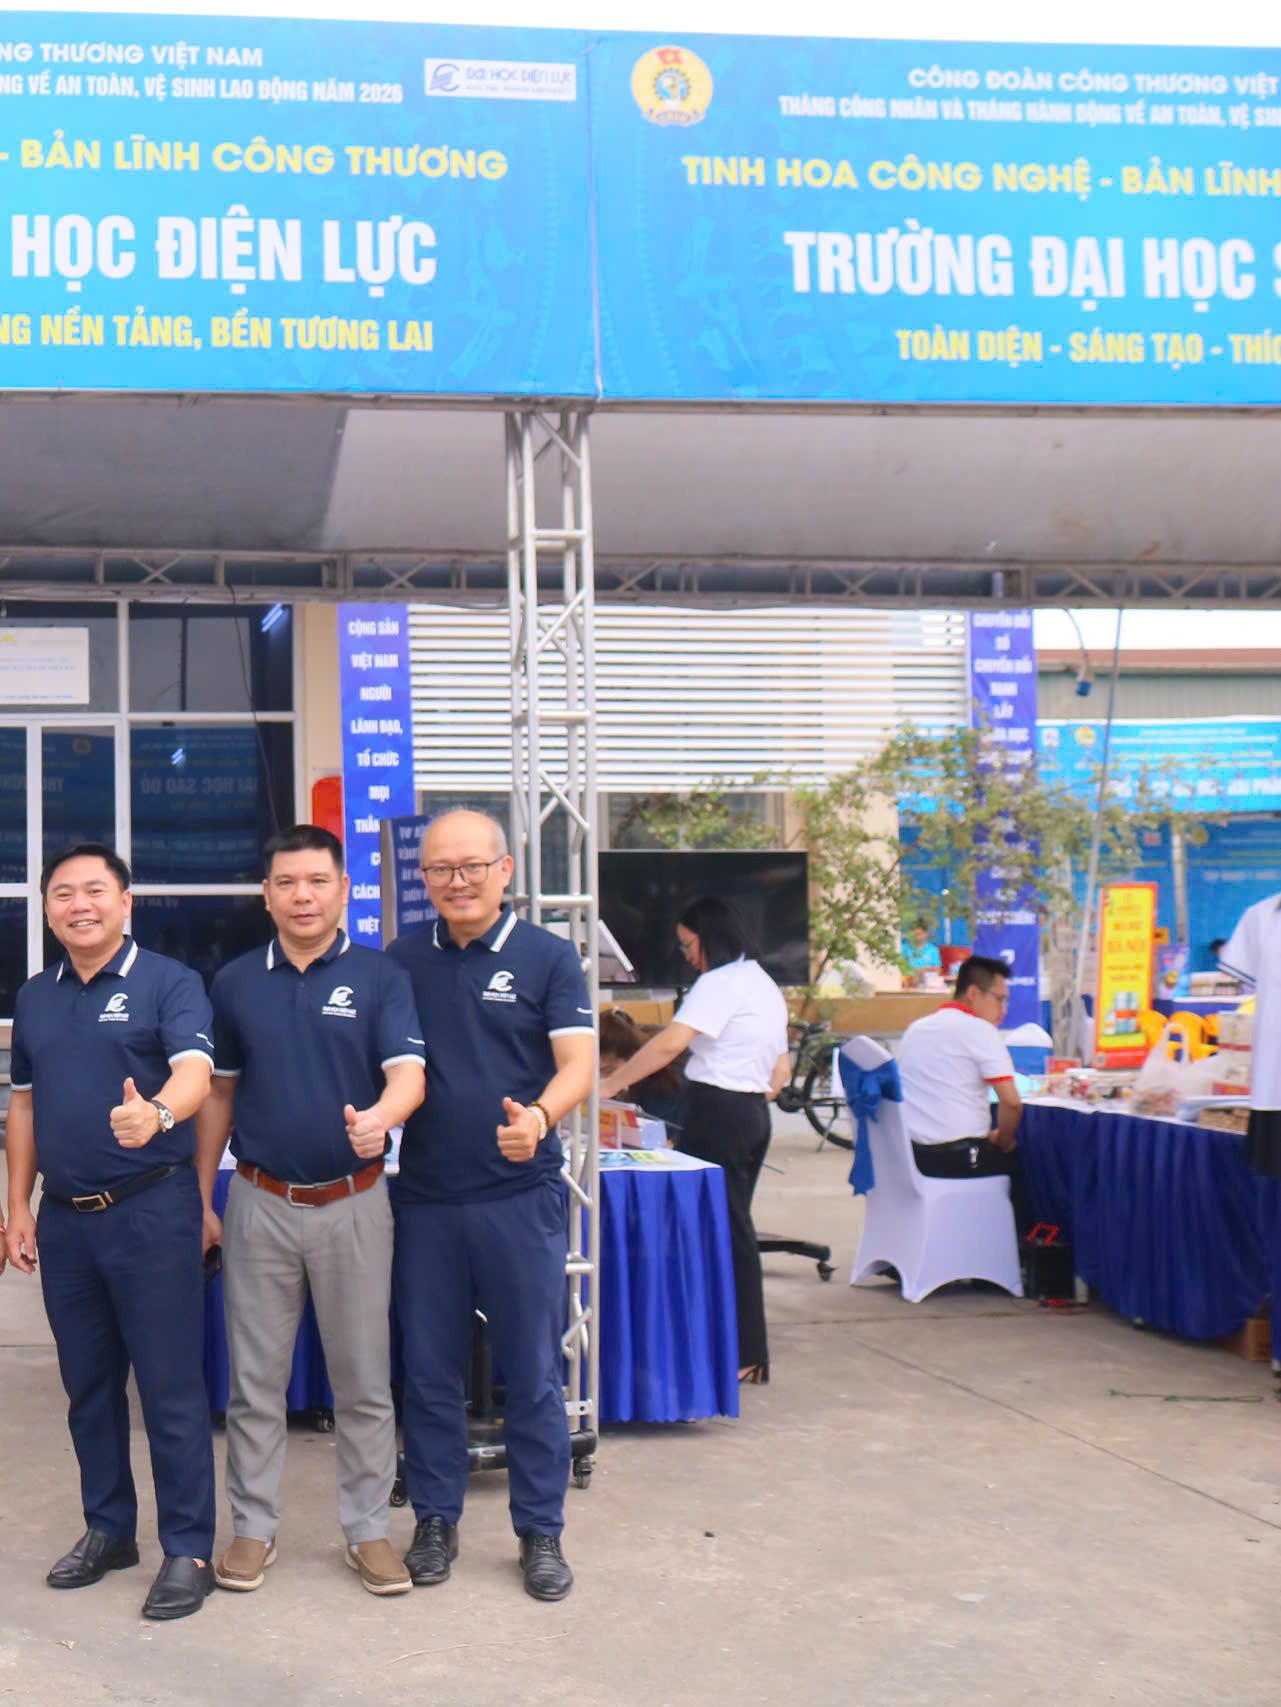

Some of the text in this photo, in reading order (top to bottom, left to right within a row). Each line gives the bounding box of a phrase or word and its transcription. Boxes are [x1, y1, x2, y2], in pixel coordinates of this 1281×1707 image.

[40, 41, 145, 64] THƯƠNG
[151, 41, 200, 70] VIỆT
[206, 47, 263, 67] NAM
[27, 69, 51, 95] VỀ
[55, 75, 82, 96] AN
[86, 72, 140, 98] TOÀN,
[144, 73, 167, 101] VỆ
[171, 77, 216, 98] SINH
[220, 78, 254, 99] LAO
[258, 77, 308, 104] ĐỘNG
[312, 78, 355, 102] NĂM
[359, 83, 403, 103] 2026
[908, 64, 1280, 100] CÔNG ĐOÀN CÔNG THƯƠNG VIỆT
[21, 129, 100, 169] BẢN
[114, 134, 200, 171] LĨNH
[212, 136, 336, 175] CÔNG
[345, 144, 508, 180] THƯƠNG
[682, 153, 1281, 201] TINH HOA CÔNG NGHỆ BẢN LĨNH
[12, 214, 136, 292] HỌC
[155, 204, 302, 295] ĐIỆN
[323, 215, 436, 298] LỰC
[784, 218, 1014, 296] TRƯỜNG
[1029, 236, 1125, 311] ĐẠI
[1143, 237, 1256, 312] HỌC
[40, 305, 104, 346] NỀN
[112, 305, 202, 351] TẢNG,
[211, 307, 272, 348] BỀN
[280, 316, 379, 350] TƯƠNG
[388, 320, 433, 351] LAI
[896, 324, 970, 360] TOÀN
[977, 325, 1043, 368] DIỆN
[1069, 326, 1145, 363] SÁNG
[1151, 332, 1204, 369] TẠO
